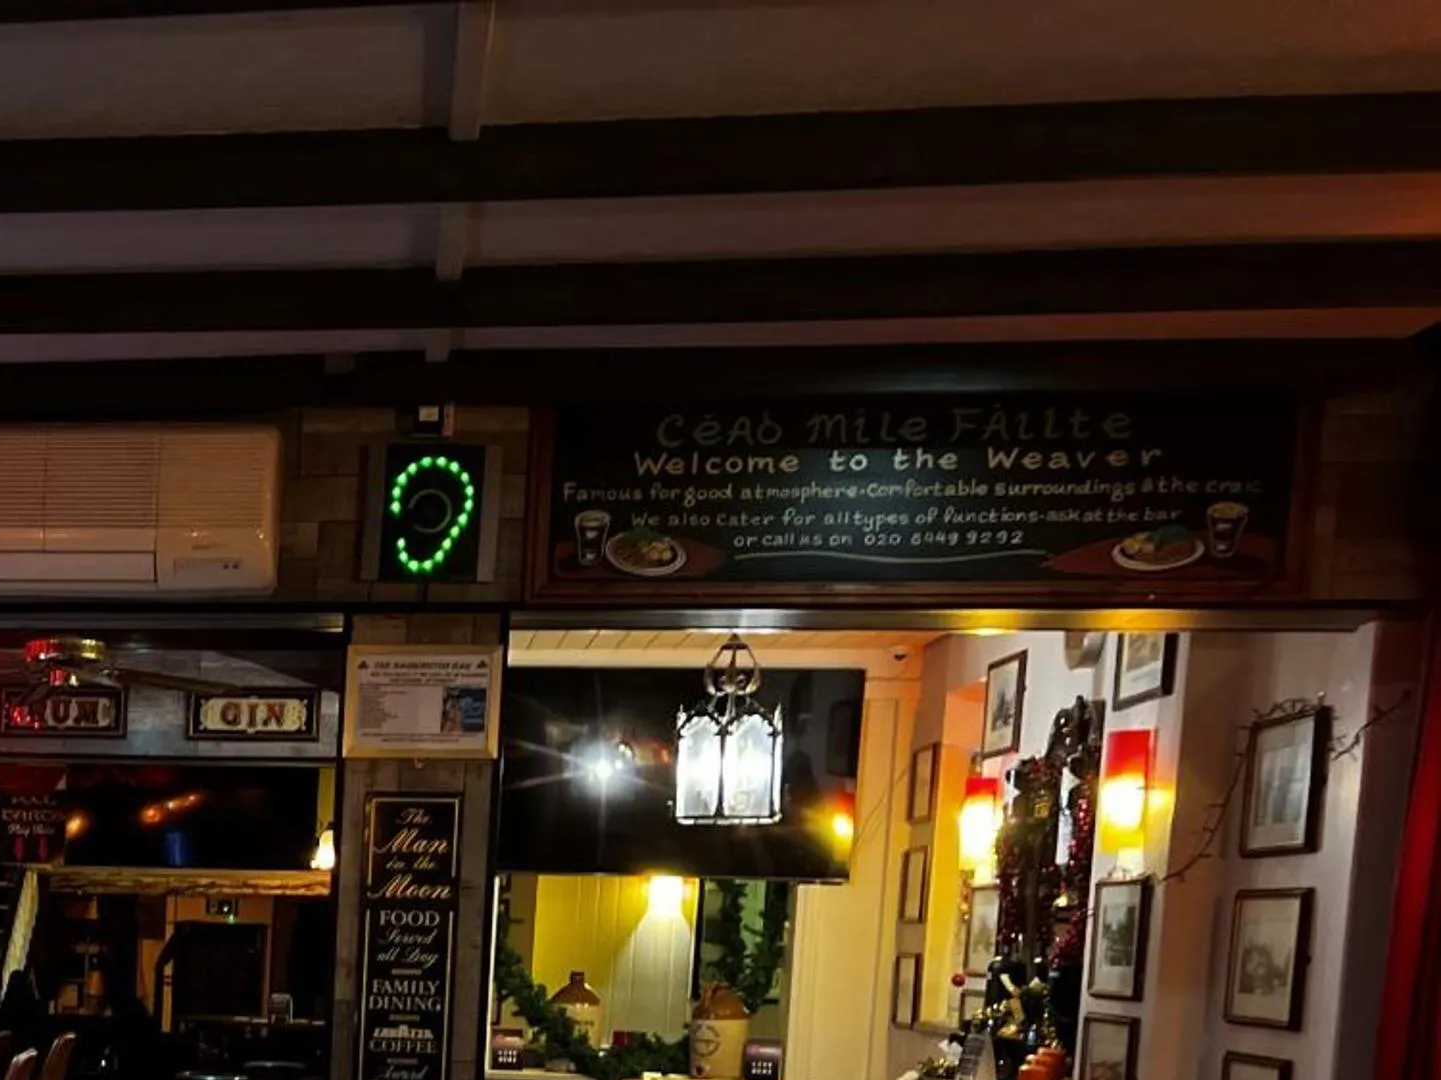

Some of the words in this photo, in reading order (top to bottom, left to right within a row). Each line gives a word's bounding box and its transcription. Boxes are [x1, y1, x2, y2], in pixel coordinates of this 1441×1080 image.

[633, 449, 801, 477] Welcome
[828, 449, 869, 473] to
[893, 447, 959, 471] the
[987, 445, 1164, 471] Weaver
[562, 480, 644, 502] Famous
[649, 481, 682, 501] for
[683, 482, 734, 508] good
[994, 478, 1136, 502] surroundings
[1157, 475, 1201, 494] the
[630, 511, 661, 527] We
[667, 511, 710, 527] also
[715, 511, 776, 527] cater
[781, 507, 817, 526] for
[914, 506, 939, 525] of
[1143, 507, 1185, 522] bar
[733, 534, 758, 548] or
[761, 532, 795, 547] call
[798, 533, 824, 547] us
[828, 533, 854, 547] on
[863, 531, 902, 547] 020
[220, 702, 284, 726] GIN
[373, 828, 448, 854] Man
[366, 874, 451, 900] Moon
[379, 909, 440, 928] FOOD
[371, 978, 440, 996] FAMILY
[368, 995, 442, 1012] DINING
[368, 1038, 437, 1054] COFFEE
